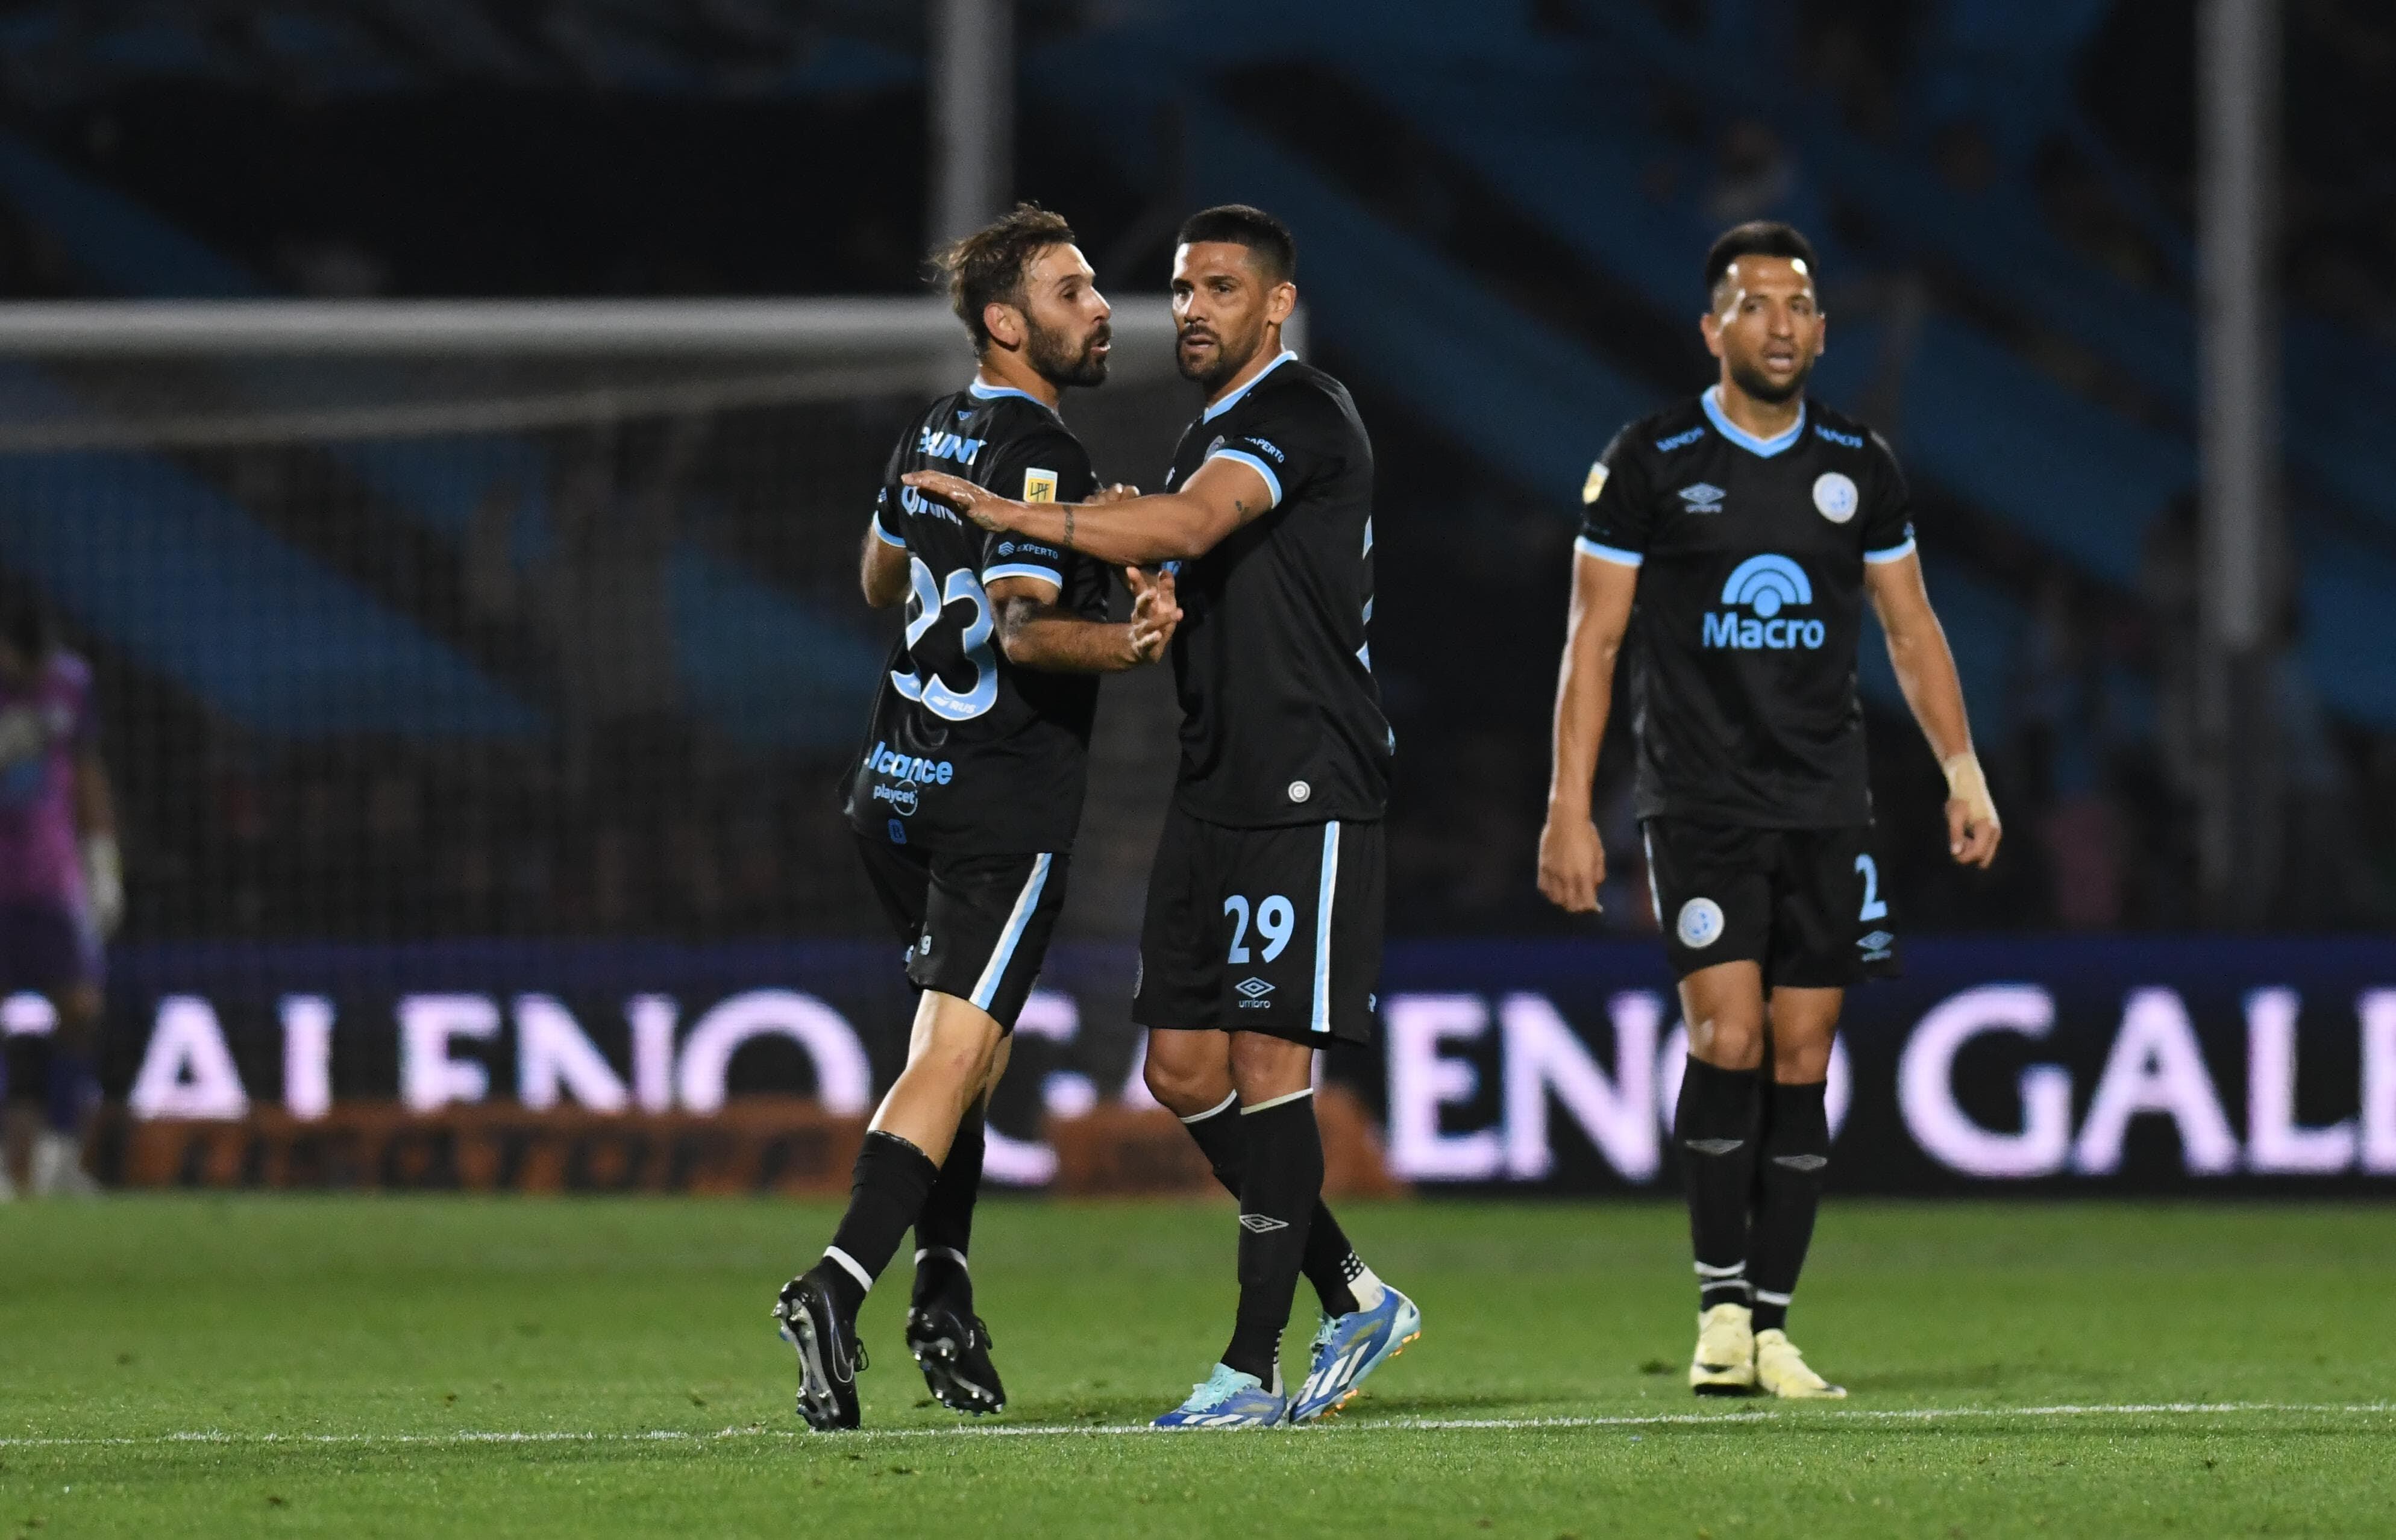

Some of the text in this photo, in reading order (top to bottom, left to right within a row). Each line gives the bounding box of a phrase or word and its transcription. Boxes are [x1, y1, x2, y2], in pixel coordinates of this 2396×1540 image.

[1244, 437, 1284, 463] PERTO
[1017, 543, 1058, 560] EXPERTO
[1702, 611, 1825, 649] Macro
[864, 740, 953, 785] lcance
[1854, 853, 1888, 922] 2
[1224, 894, 1295, 964] 29
[1238, 998, 1271, 1009] umbro
[0, 987, 871, 1119] AENO
[1895, 981, 2396, 1179] GAL
